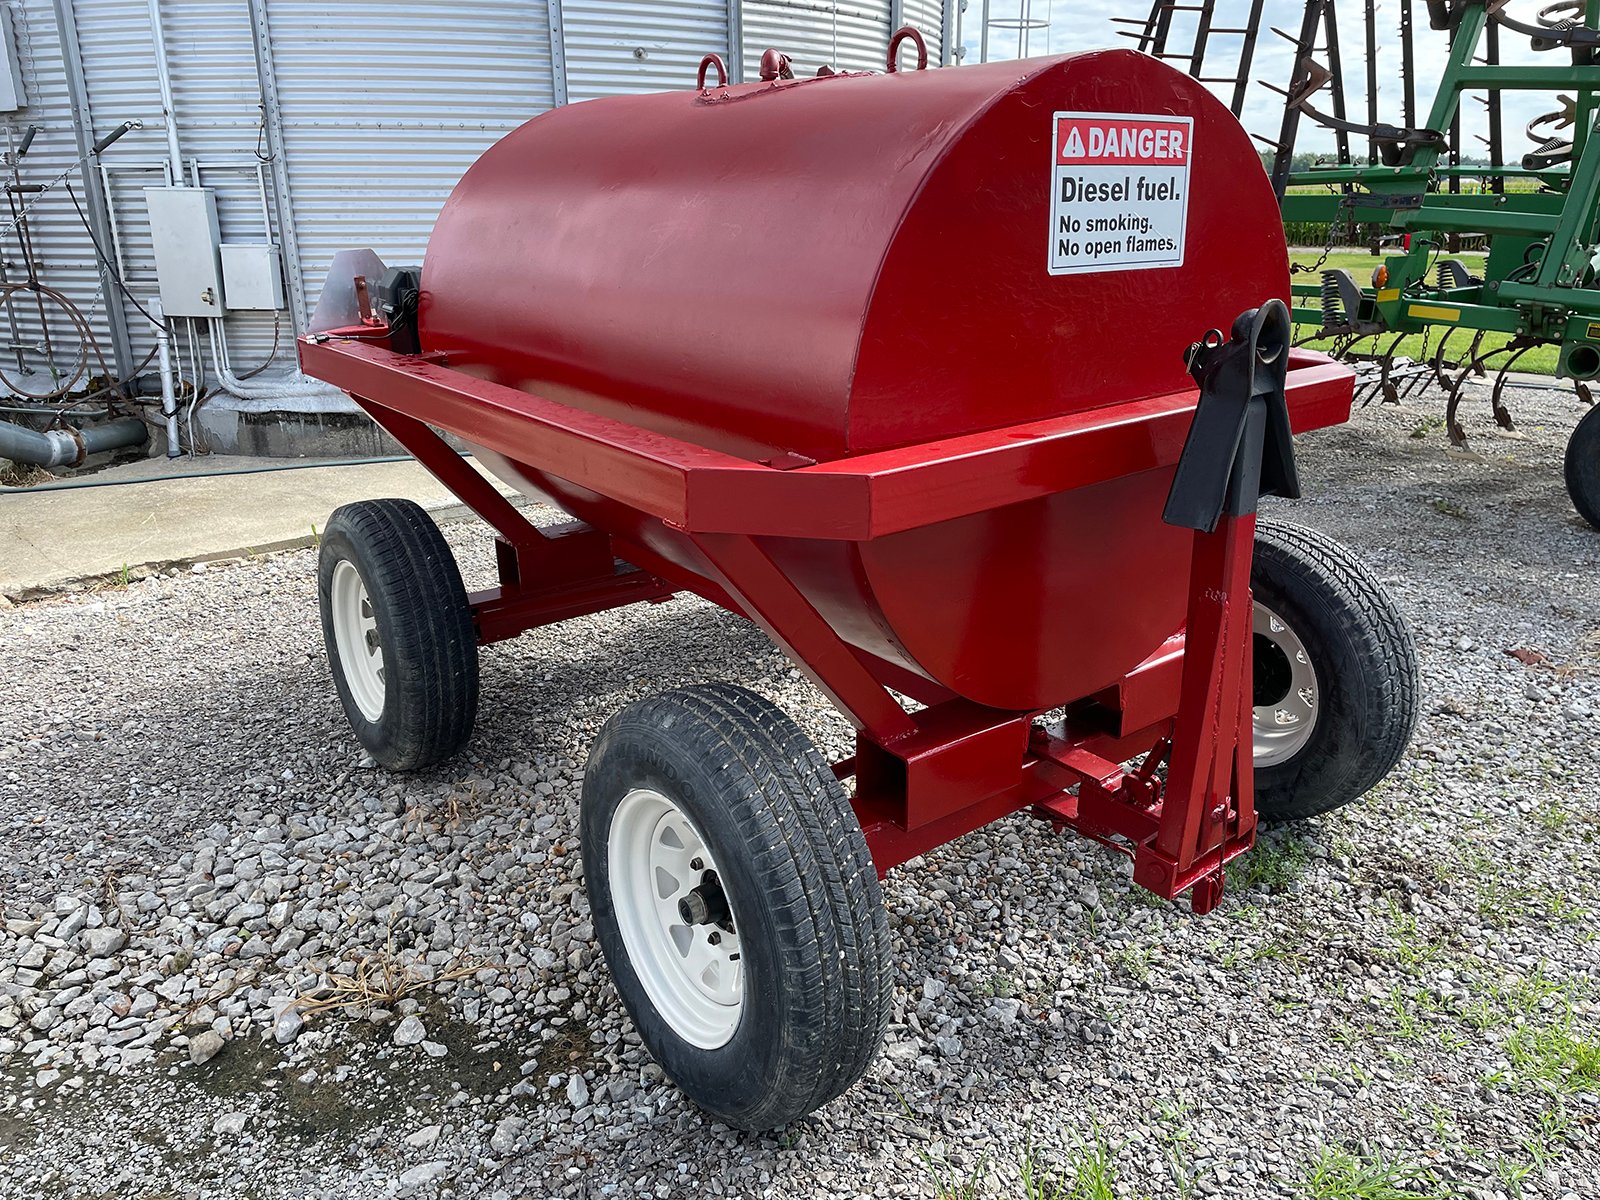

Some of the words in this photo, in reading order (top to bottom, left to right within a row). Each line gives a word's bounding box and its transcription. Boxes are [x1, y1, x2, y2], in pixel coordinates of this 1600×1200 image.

[1088, 127, 1183, 159] DANGER
[1061, 177, 1130, 202] Diesel
[1137, 176, 1180, 200] fuel.
[1059, 215, 1081, 233] No
[1086, 213, 1153, 234] smoking.
[1058, 239, 1080, 256] No
[1085, 240, 1121, 258] open
[1126, 236, 1177, 252] flames.
